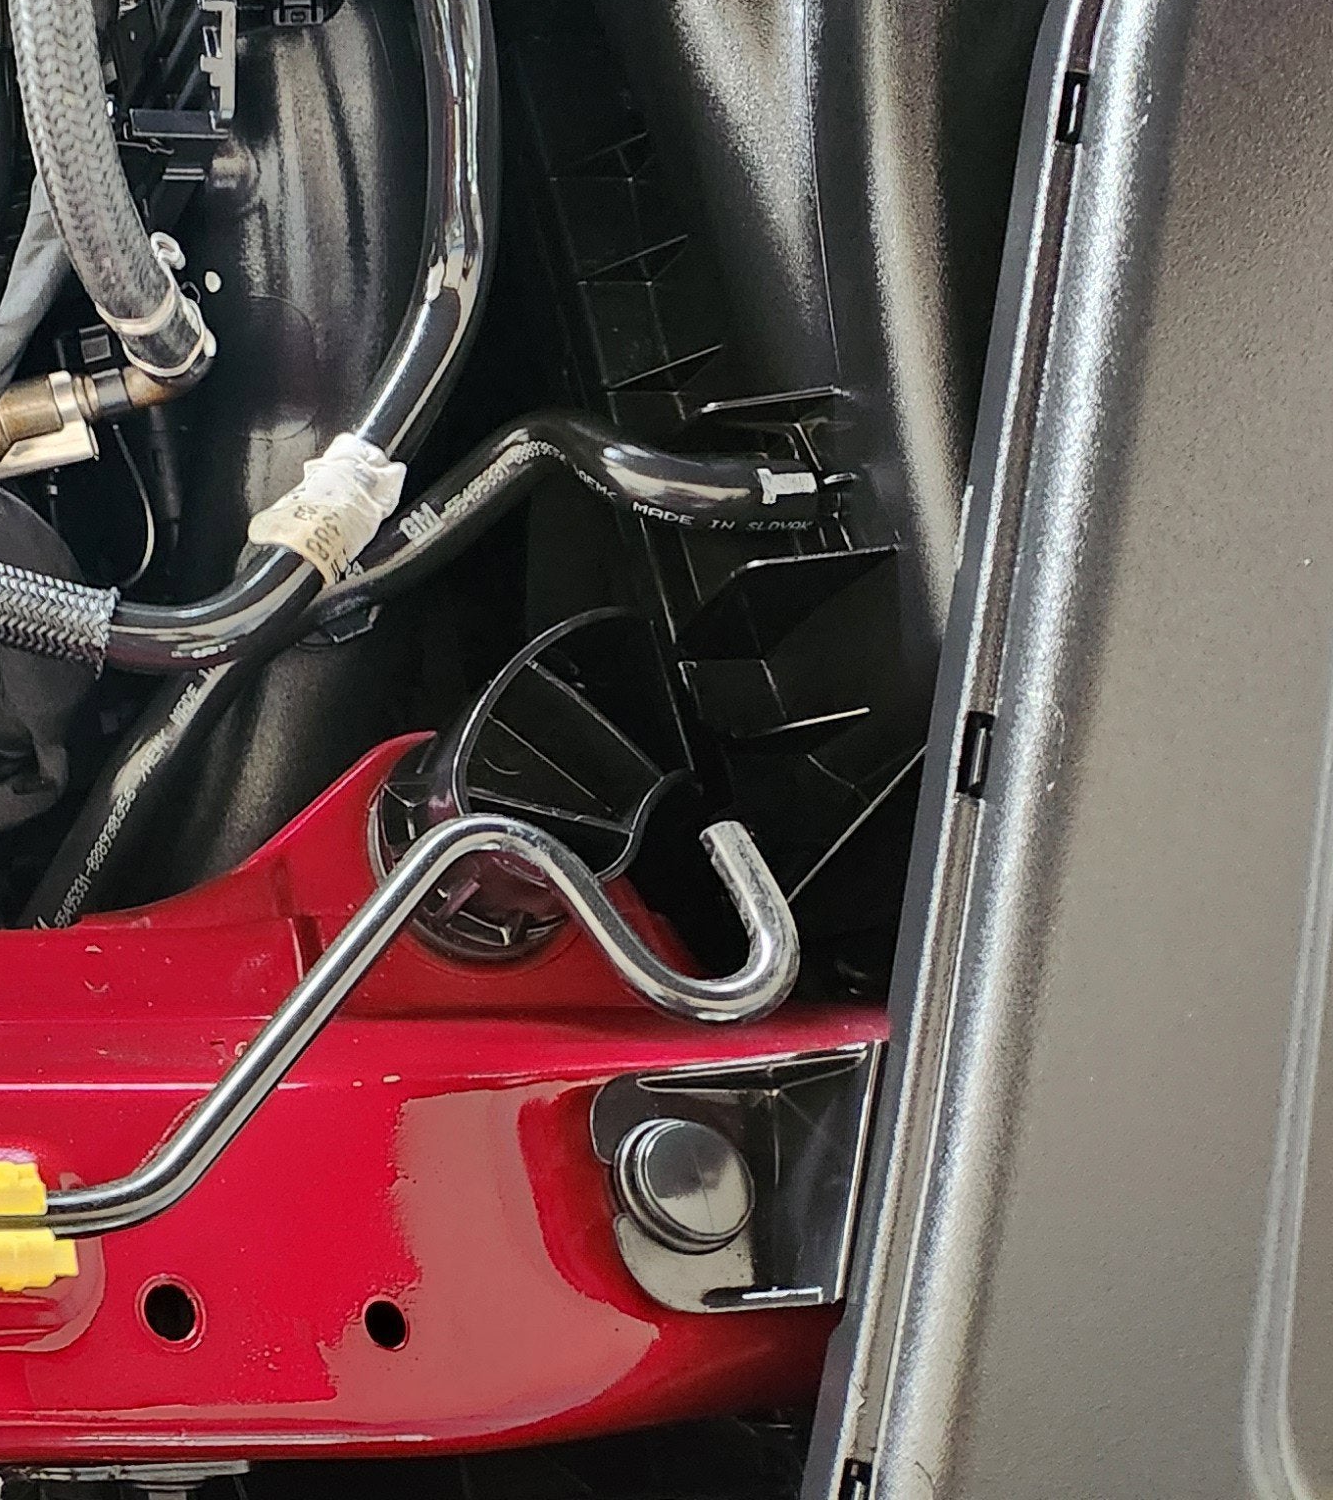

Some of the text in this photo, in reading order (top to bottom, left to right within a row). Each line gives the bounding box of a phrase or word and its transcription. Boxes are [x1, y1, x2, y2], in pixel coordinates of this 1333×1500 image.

[633, 501, 695, 526] MADE
[709, 519, 735, 531] IN
[170, 682, 202, 729] MADE
